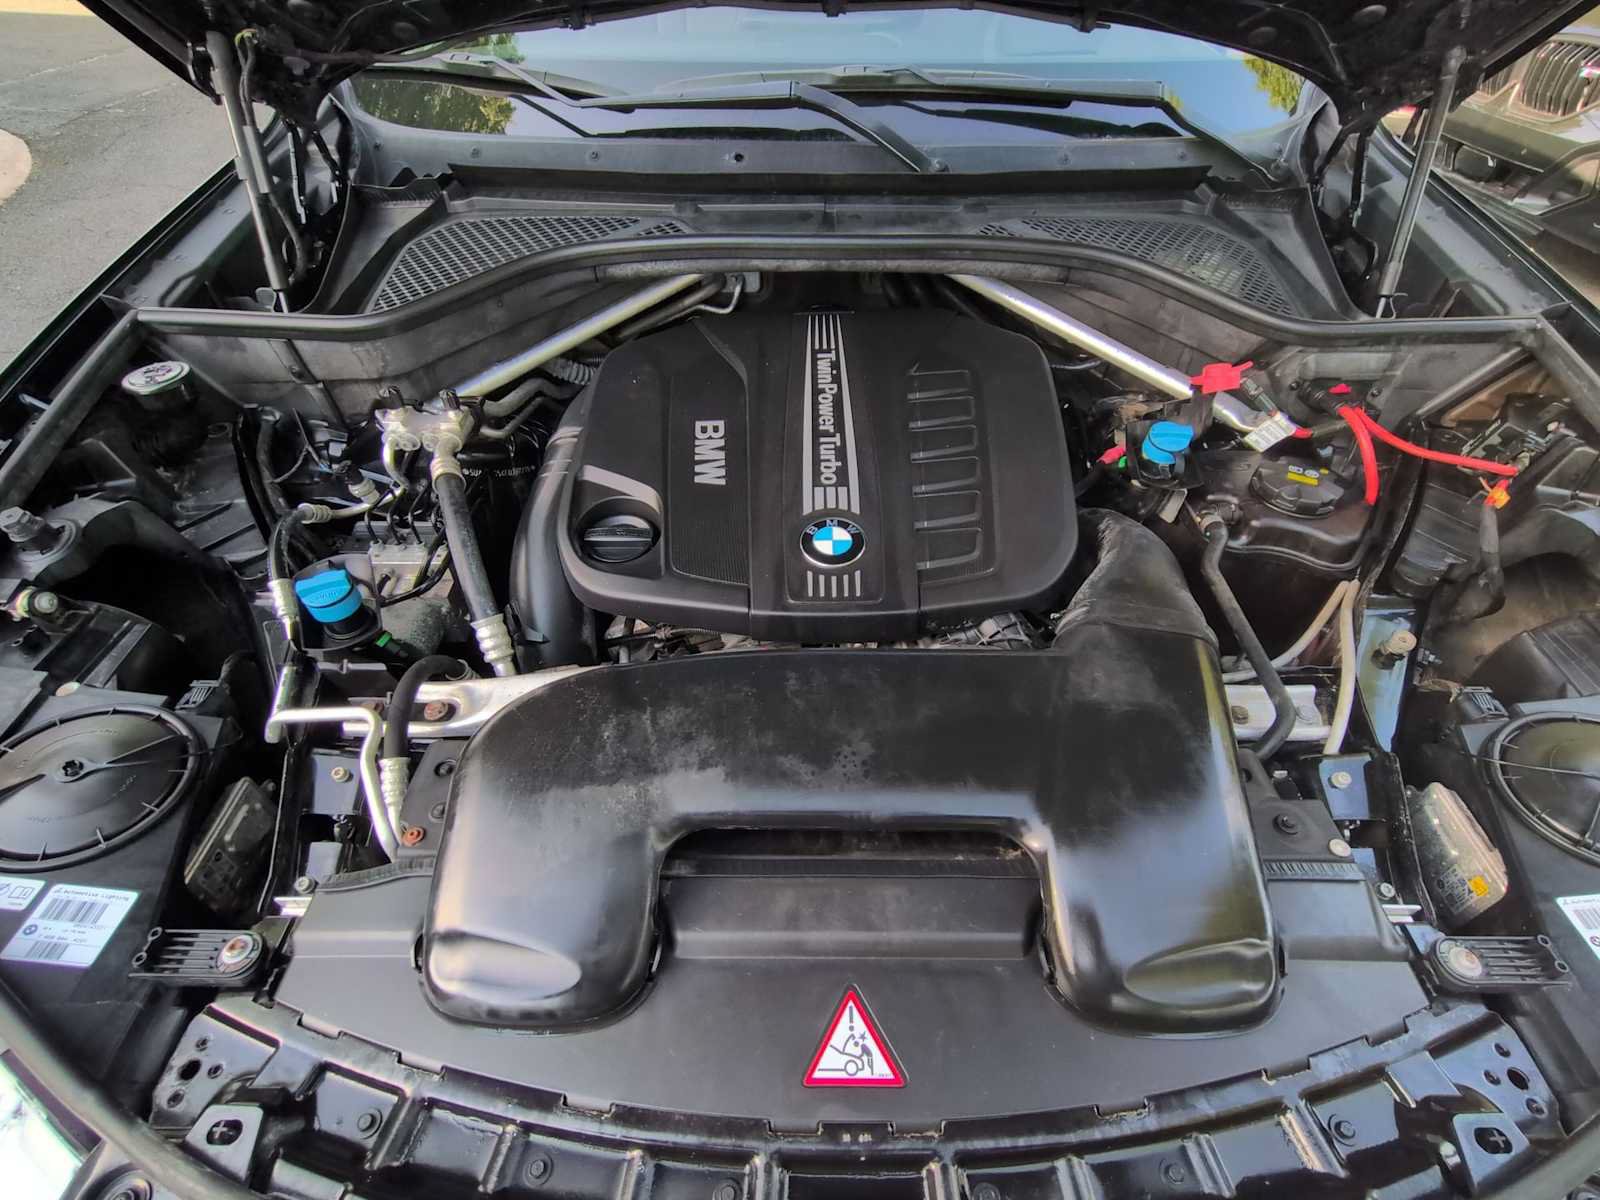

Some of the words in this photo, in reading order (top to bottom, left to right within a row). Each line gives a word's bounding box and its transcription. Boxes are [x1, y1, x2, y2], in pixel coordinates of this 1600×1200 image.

[817, 350, 838, 432] TwinPower
[694, 420, 726, 485] BMW
[820, 433, 842, 484] Turbo
[806, 519, 860, 535] BMW
